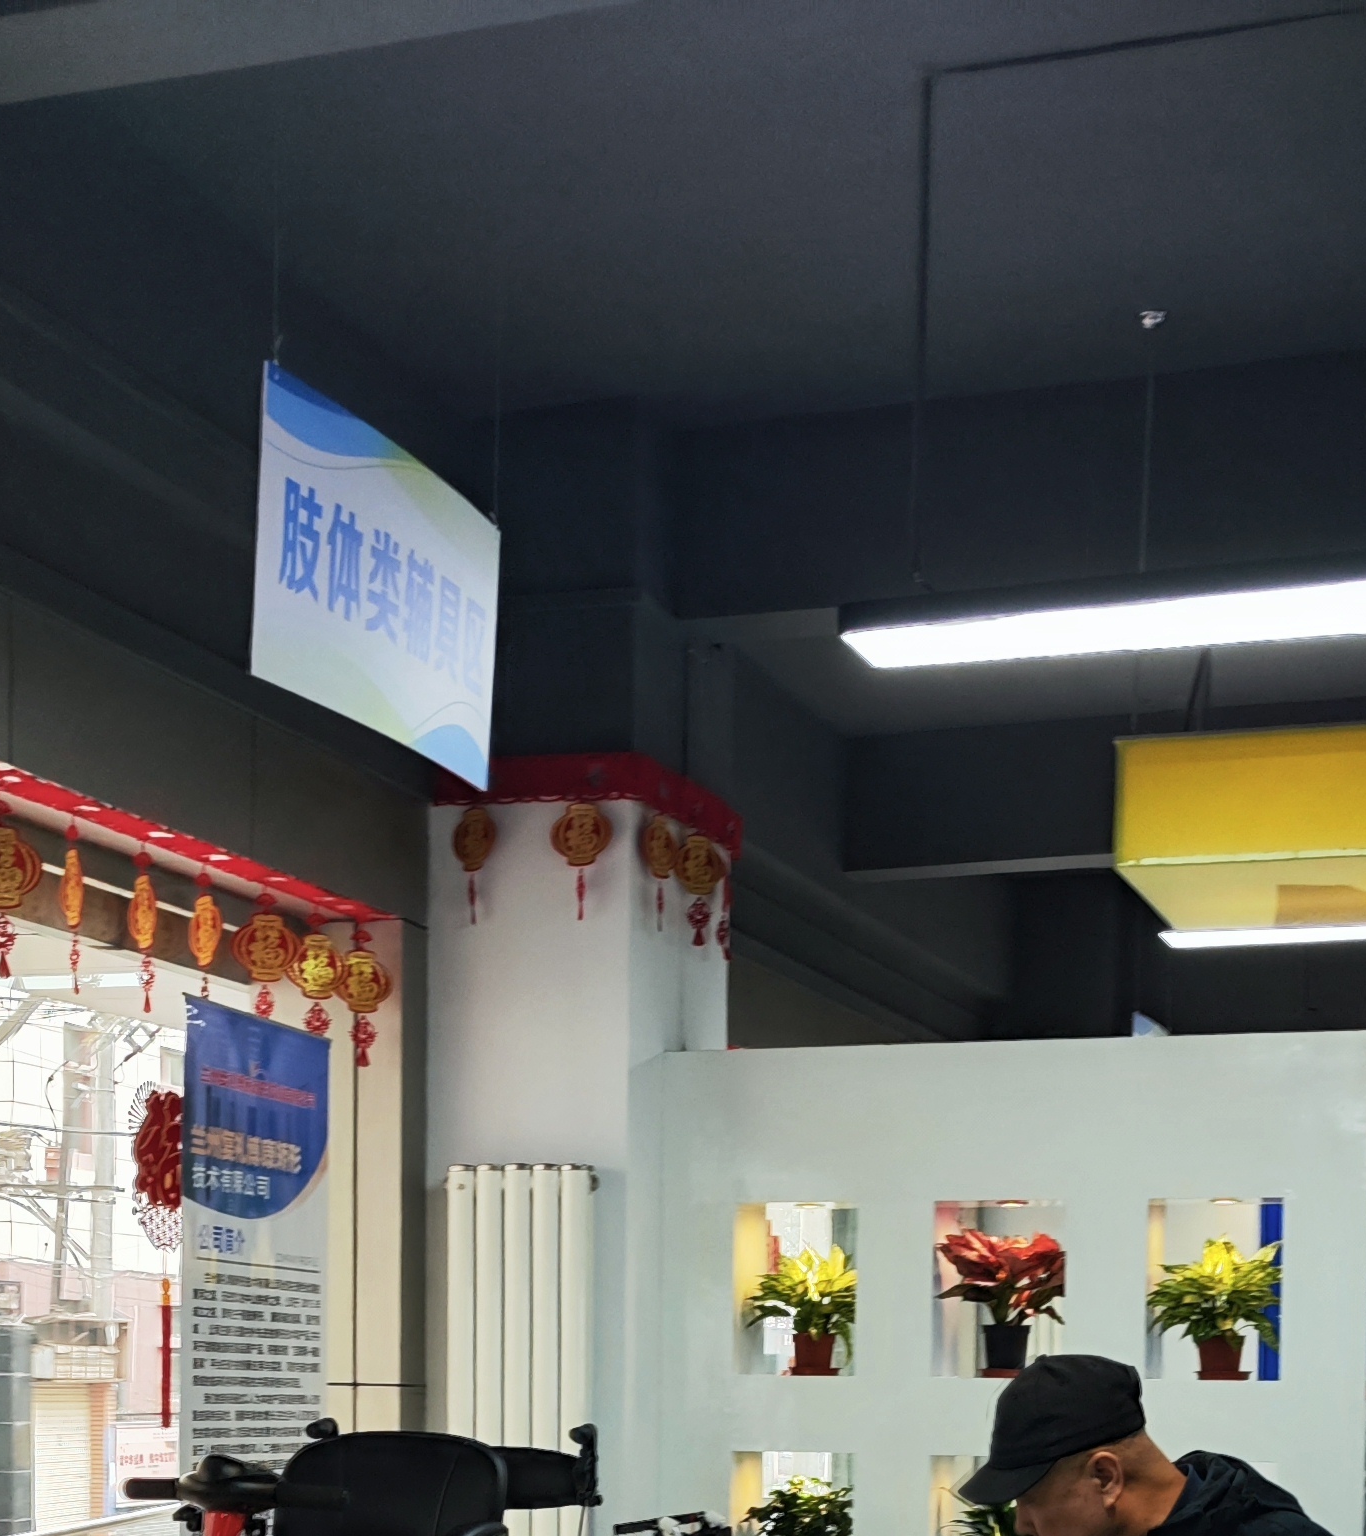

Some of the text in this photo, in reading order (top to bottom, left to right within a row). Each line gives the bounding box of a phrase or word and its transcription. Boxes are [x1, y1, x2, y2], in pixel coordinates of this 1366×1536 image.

[278, 476, 486, 698] 肢体类辅具区
